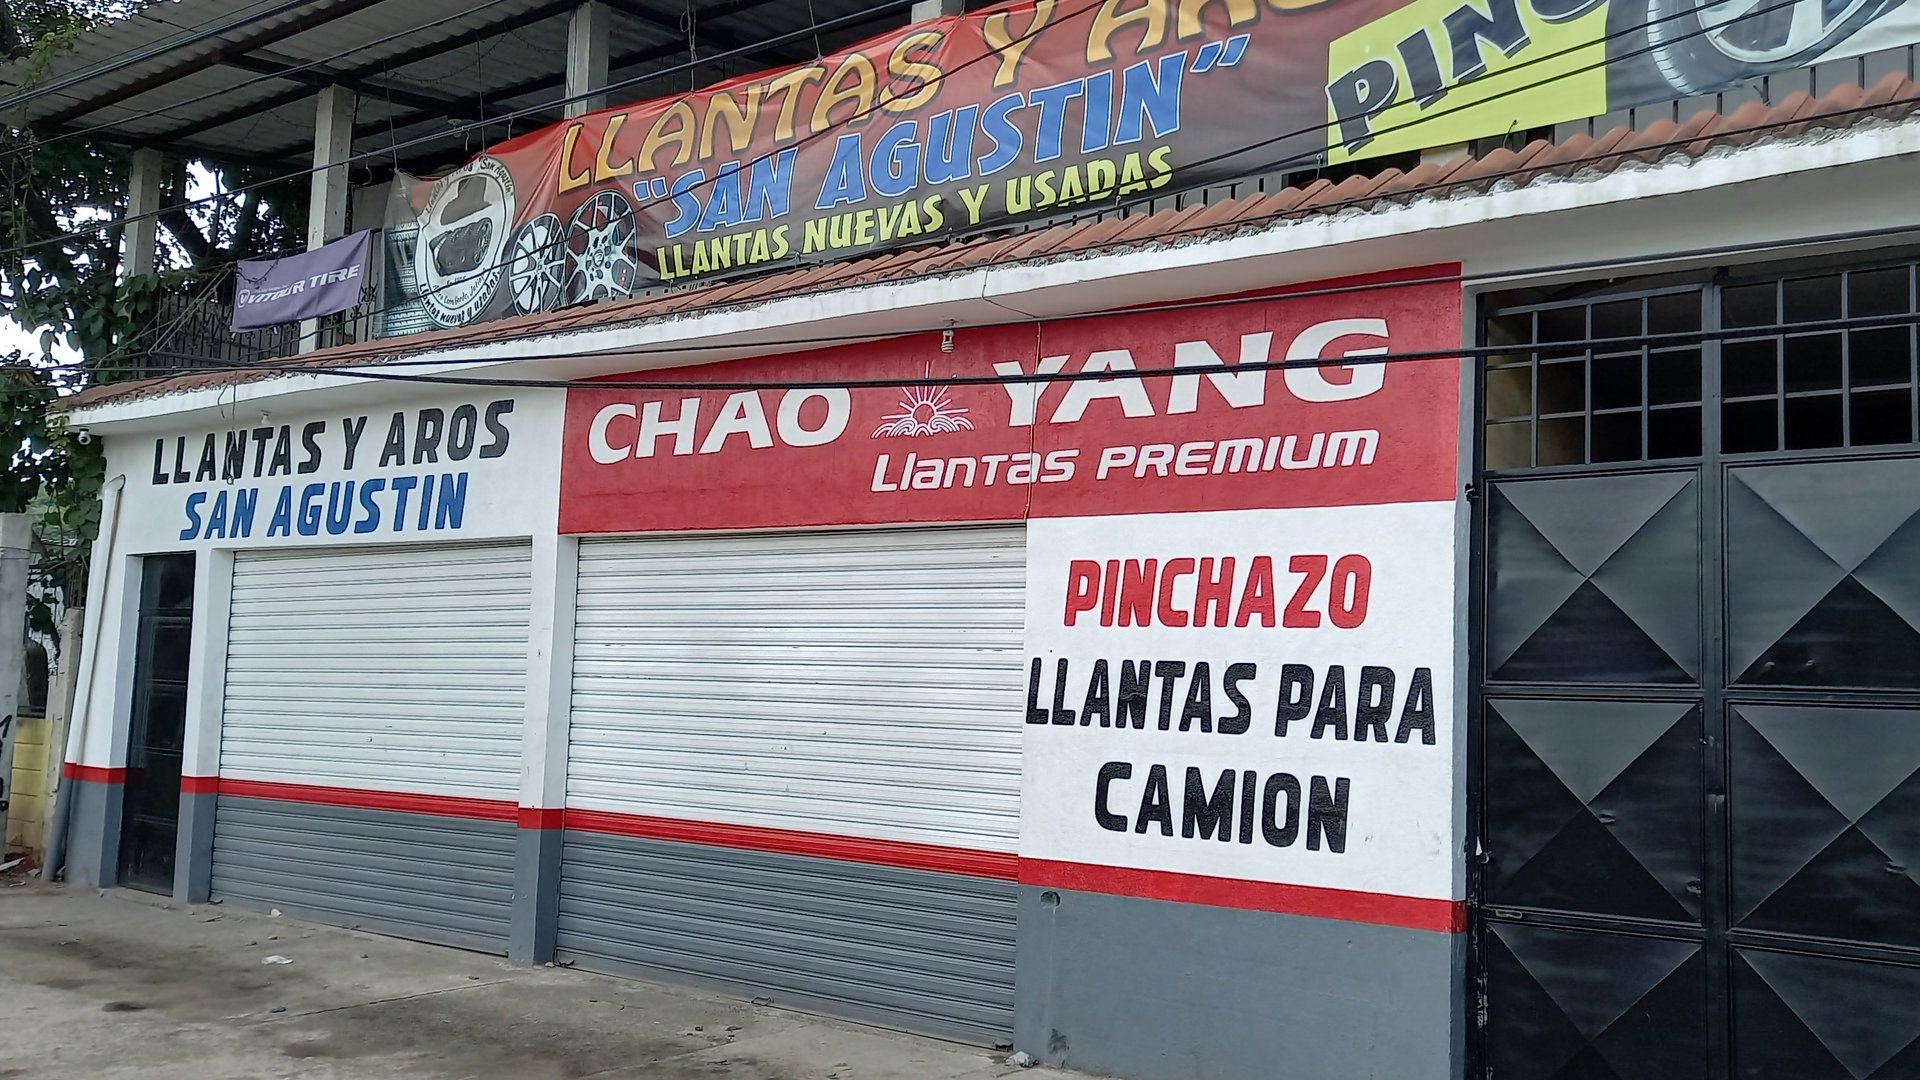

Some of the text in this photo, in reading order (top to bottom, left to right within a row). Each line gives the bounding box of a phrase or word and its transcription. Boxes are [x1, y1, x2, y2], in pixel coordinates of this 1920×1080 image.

[557, 30, 948, 195] LLANTAS
[984, 0, 1060, 88] Y
[1325, 0, 1606, 156] PIN
[656, 145, 1174, 282] LLANTAS NUEVAS Y USADAS
[309, 263, 361, 289] TIRE
[587, 317, 1390, 466] CHAO YANG
[152, 399, 515, 485] LLANTAS Y AROS
[179, 472, 469, 541] SAN AGUSTIN
[1063, 553, 1372, 629] PINCHAZO
[1025, 657, 1437, 745] LLANTAS PARA
[1094, 761, 1351, 854] CAMION
